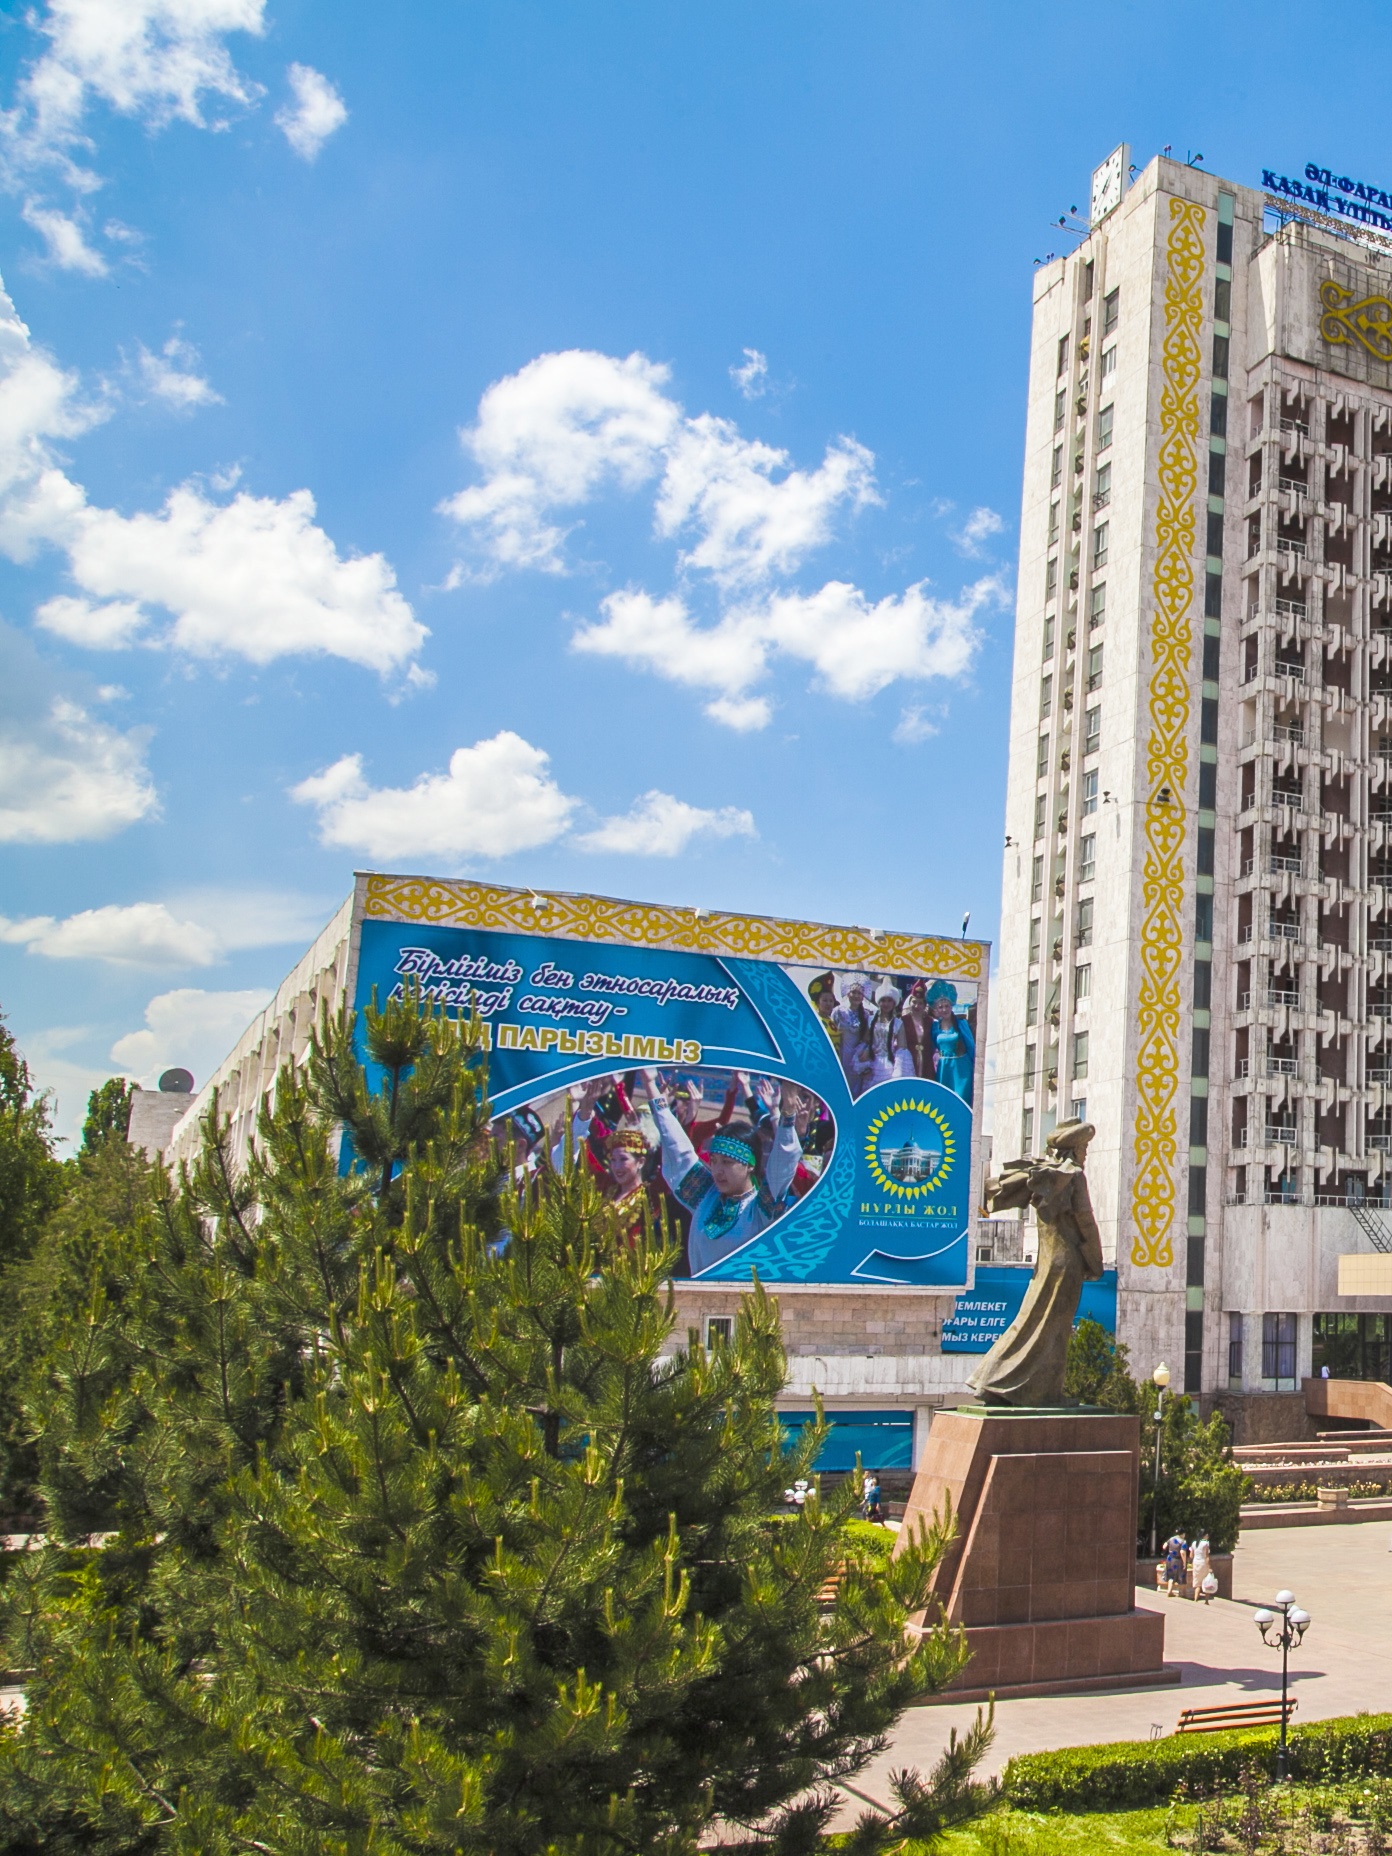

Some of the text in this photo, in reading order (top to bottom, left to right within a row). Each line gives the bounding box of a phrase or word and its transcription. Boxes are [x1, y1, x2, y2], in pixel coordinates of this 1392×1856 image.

[1261, 169, 1330, 212] ҚАЗАҚ
[394, 947, 739, 1010] Бірлігіміз бен этносаралық
[496, 1023, 702, 1064] ПАРЫЗЫМЫЗ
[923, 1205, 957, 1216] ЖОЛ
[954, 1301, 1008, 1311] ЕМЛЕКЕТ
[980, 1317, 1006, 1327] ЕЛГЕ
[941, 1332, 1003, 1342] МЫЗ КЕРЕ
